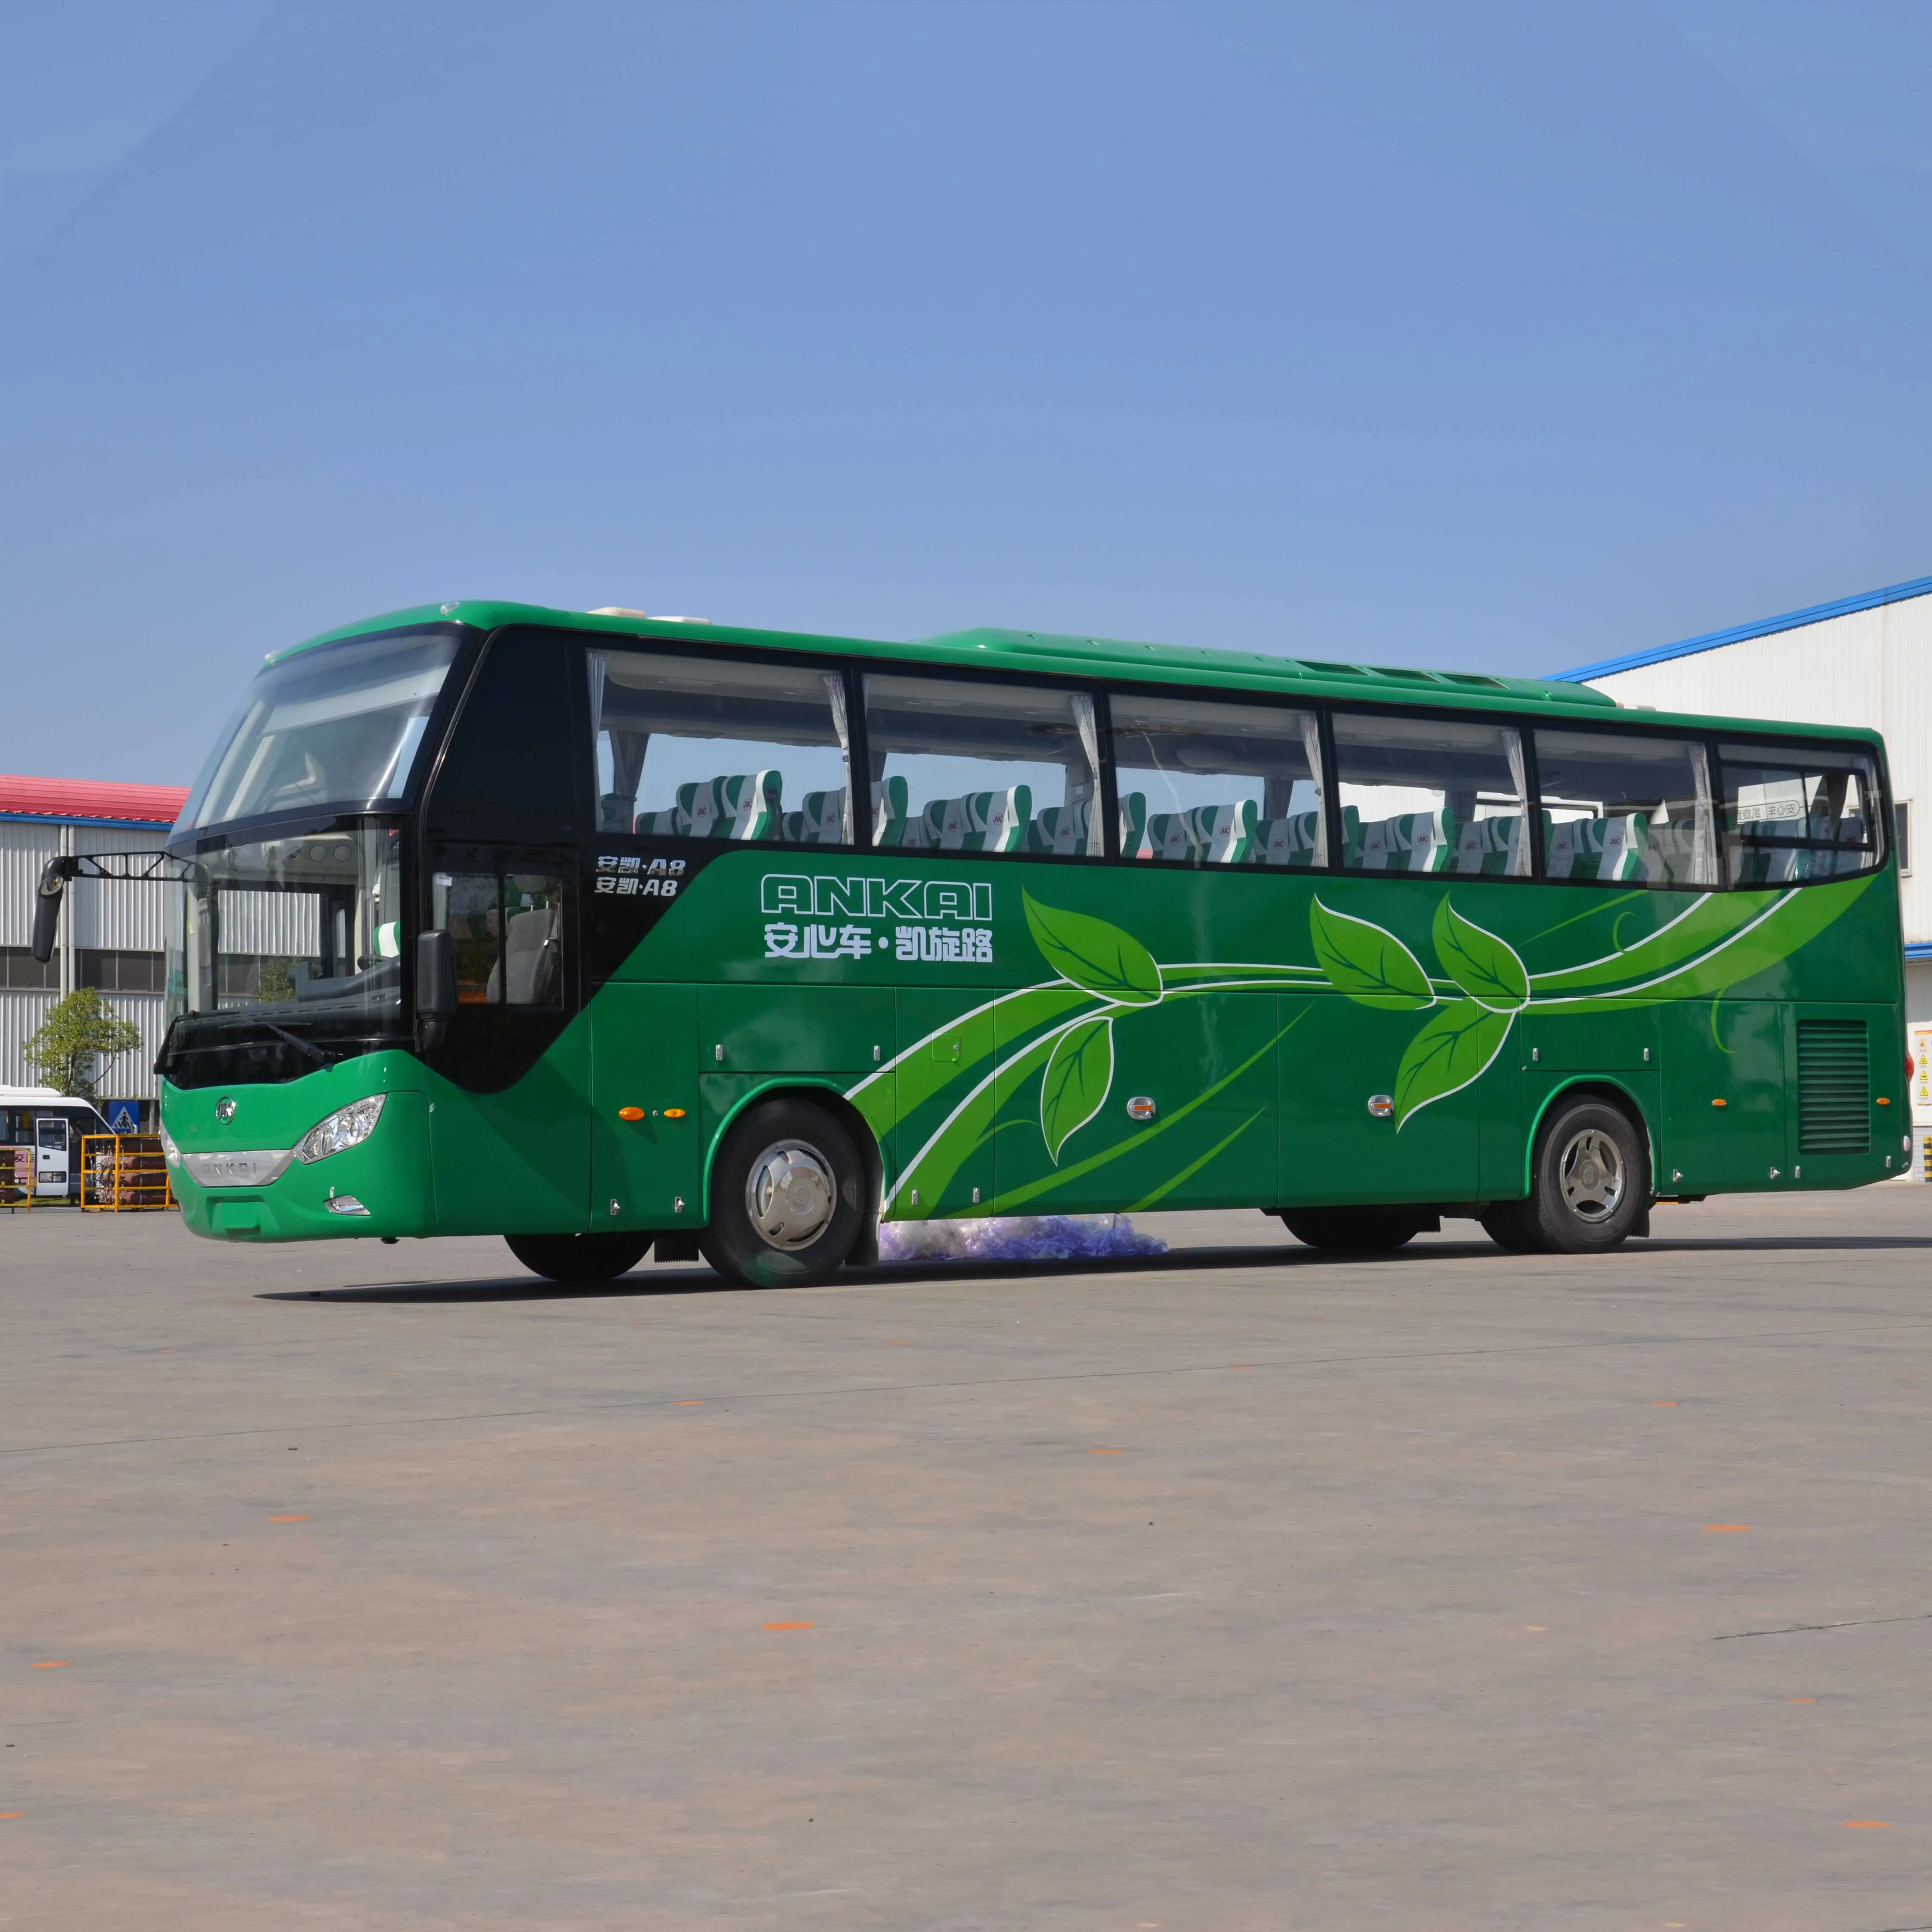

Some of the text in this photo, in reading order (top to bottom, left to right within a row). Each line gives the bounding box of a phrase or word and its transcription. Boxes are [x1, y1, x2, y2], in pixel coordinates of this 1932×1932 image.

[596, 856, 686, 876] 安凯·A8
[594, 877, 677, 896] 安凯·A8
[761, 874, 992, 920] ANKAI
[202, 1163, 257, 1175] ANKAI
